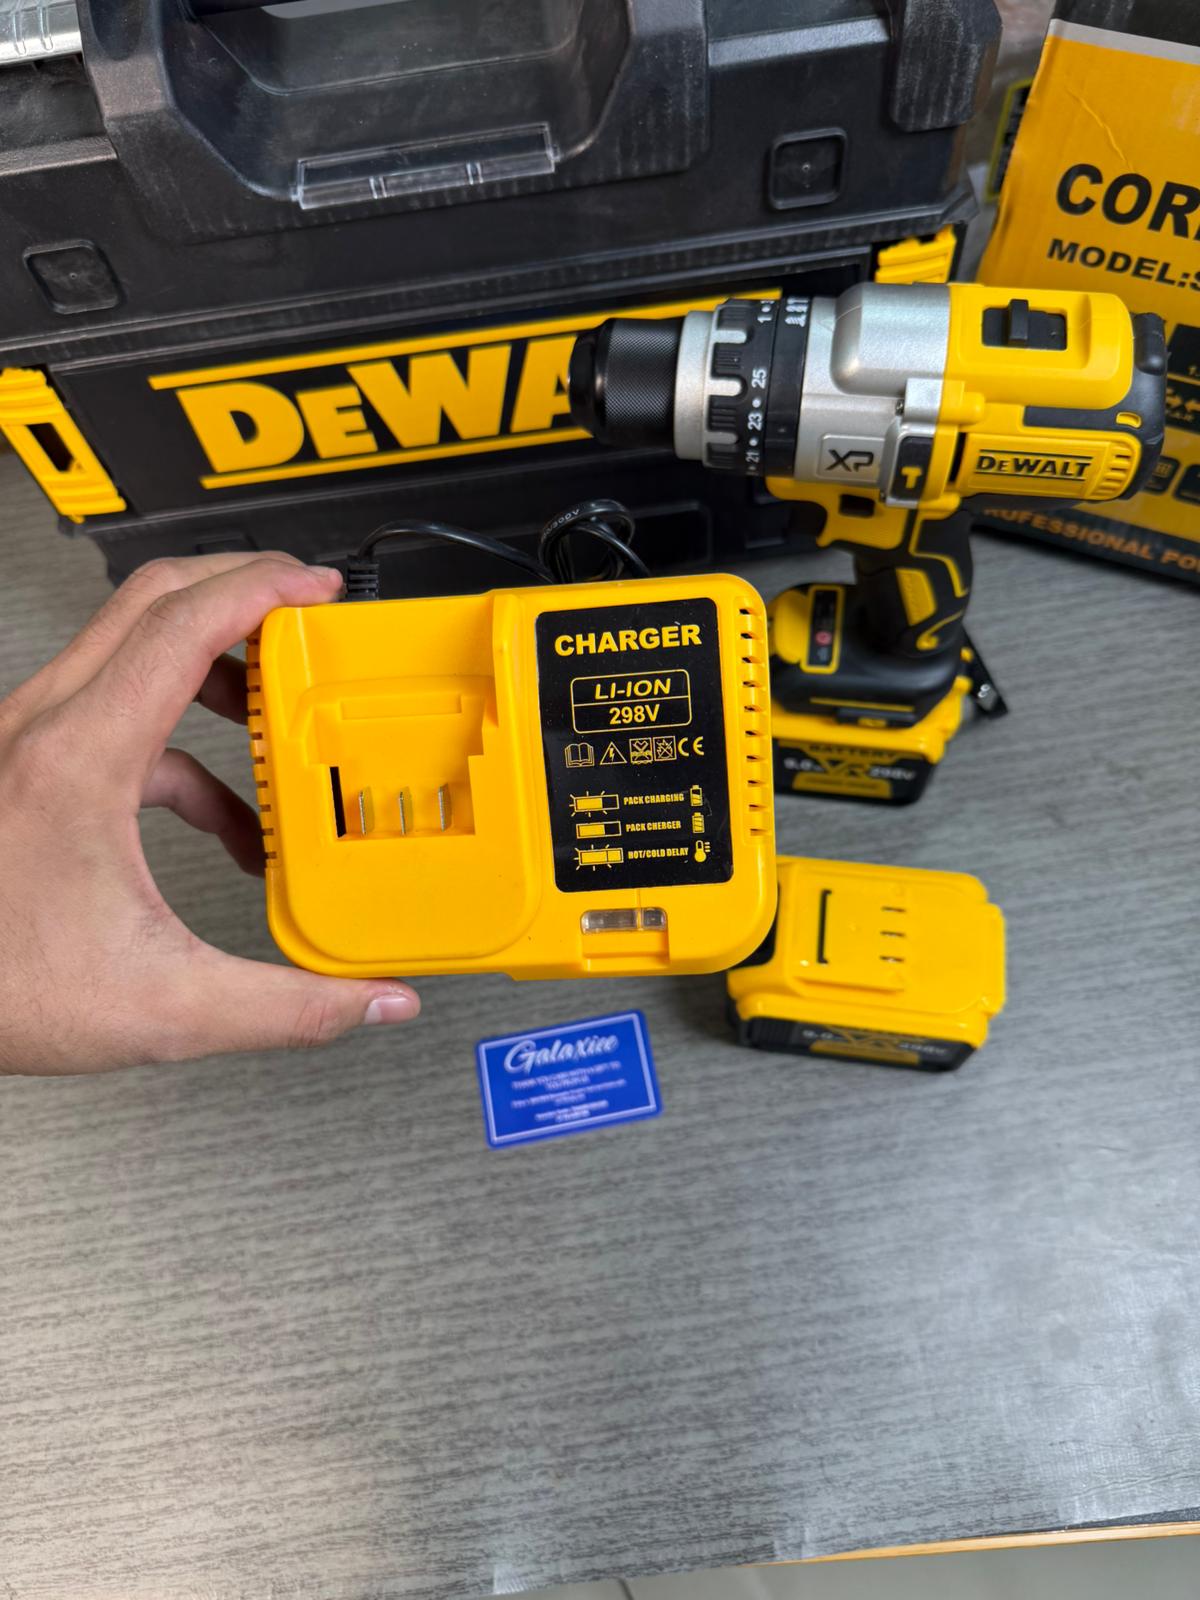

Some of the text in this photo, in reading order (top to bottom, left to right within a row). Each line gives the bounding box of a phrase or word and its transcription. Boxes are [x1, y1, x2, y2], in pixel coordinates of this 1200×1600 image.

[1056, 163, 1200, 242] COR
[751, 368, 767, 389] 25
[176, 333, 577, 474] DEWA
[747, 412, 763, 431] 23
[825, 449, 875, 473] XP
[1160, 550, 1200, 574] PO
[554, 624, 702, 657] CHARGER
[594, 677, 671, 700] LI-ION
[609, 703, 660, 725] 298V
[623, 793, 685, 806] PACK CHARGING
[625, 820, 682, 833] PACK CHERGER
[666, 847, 689, 858] DELAY
